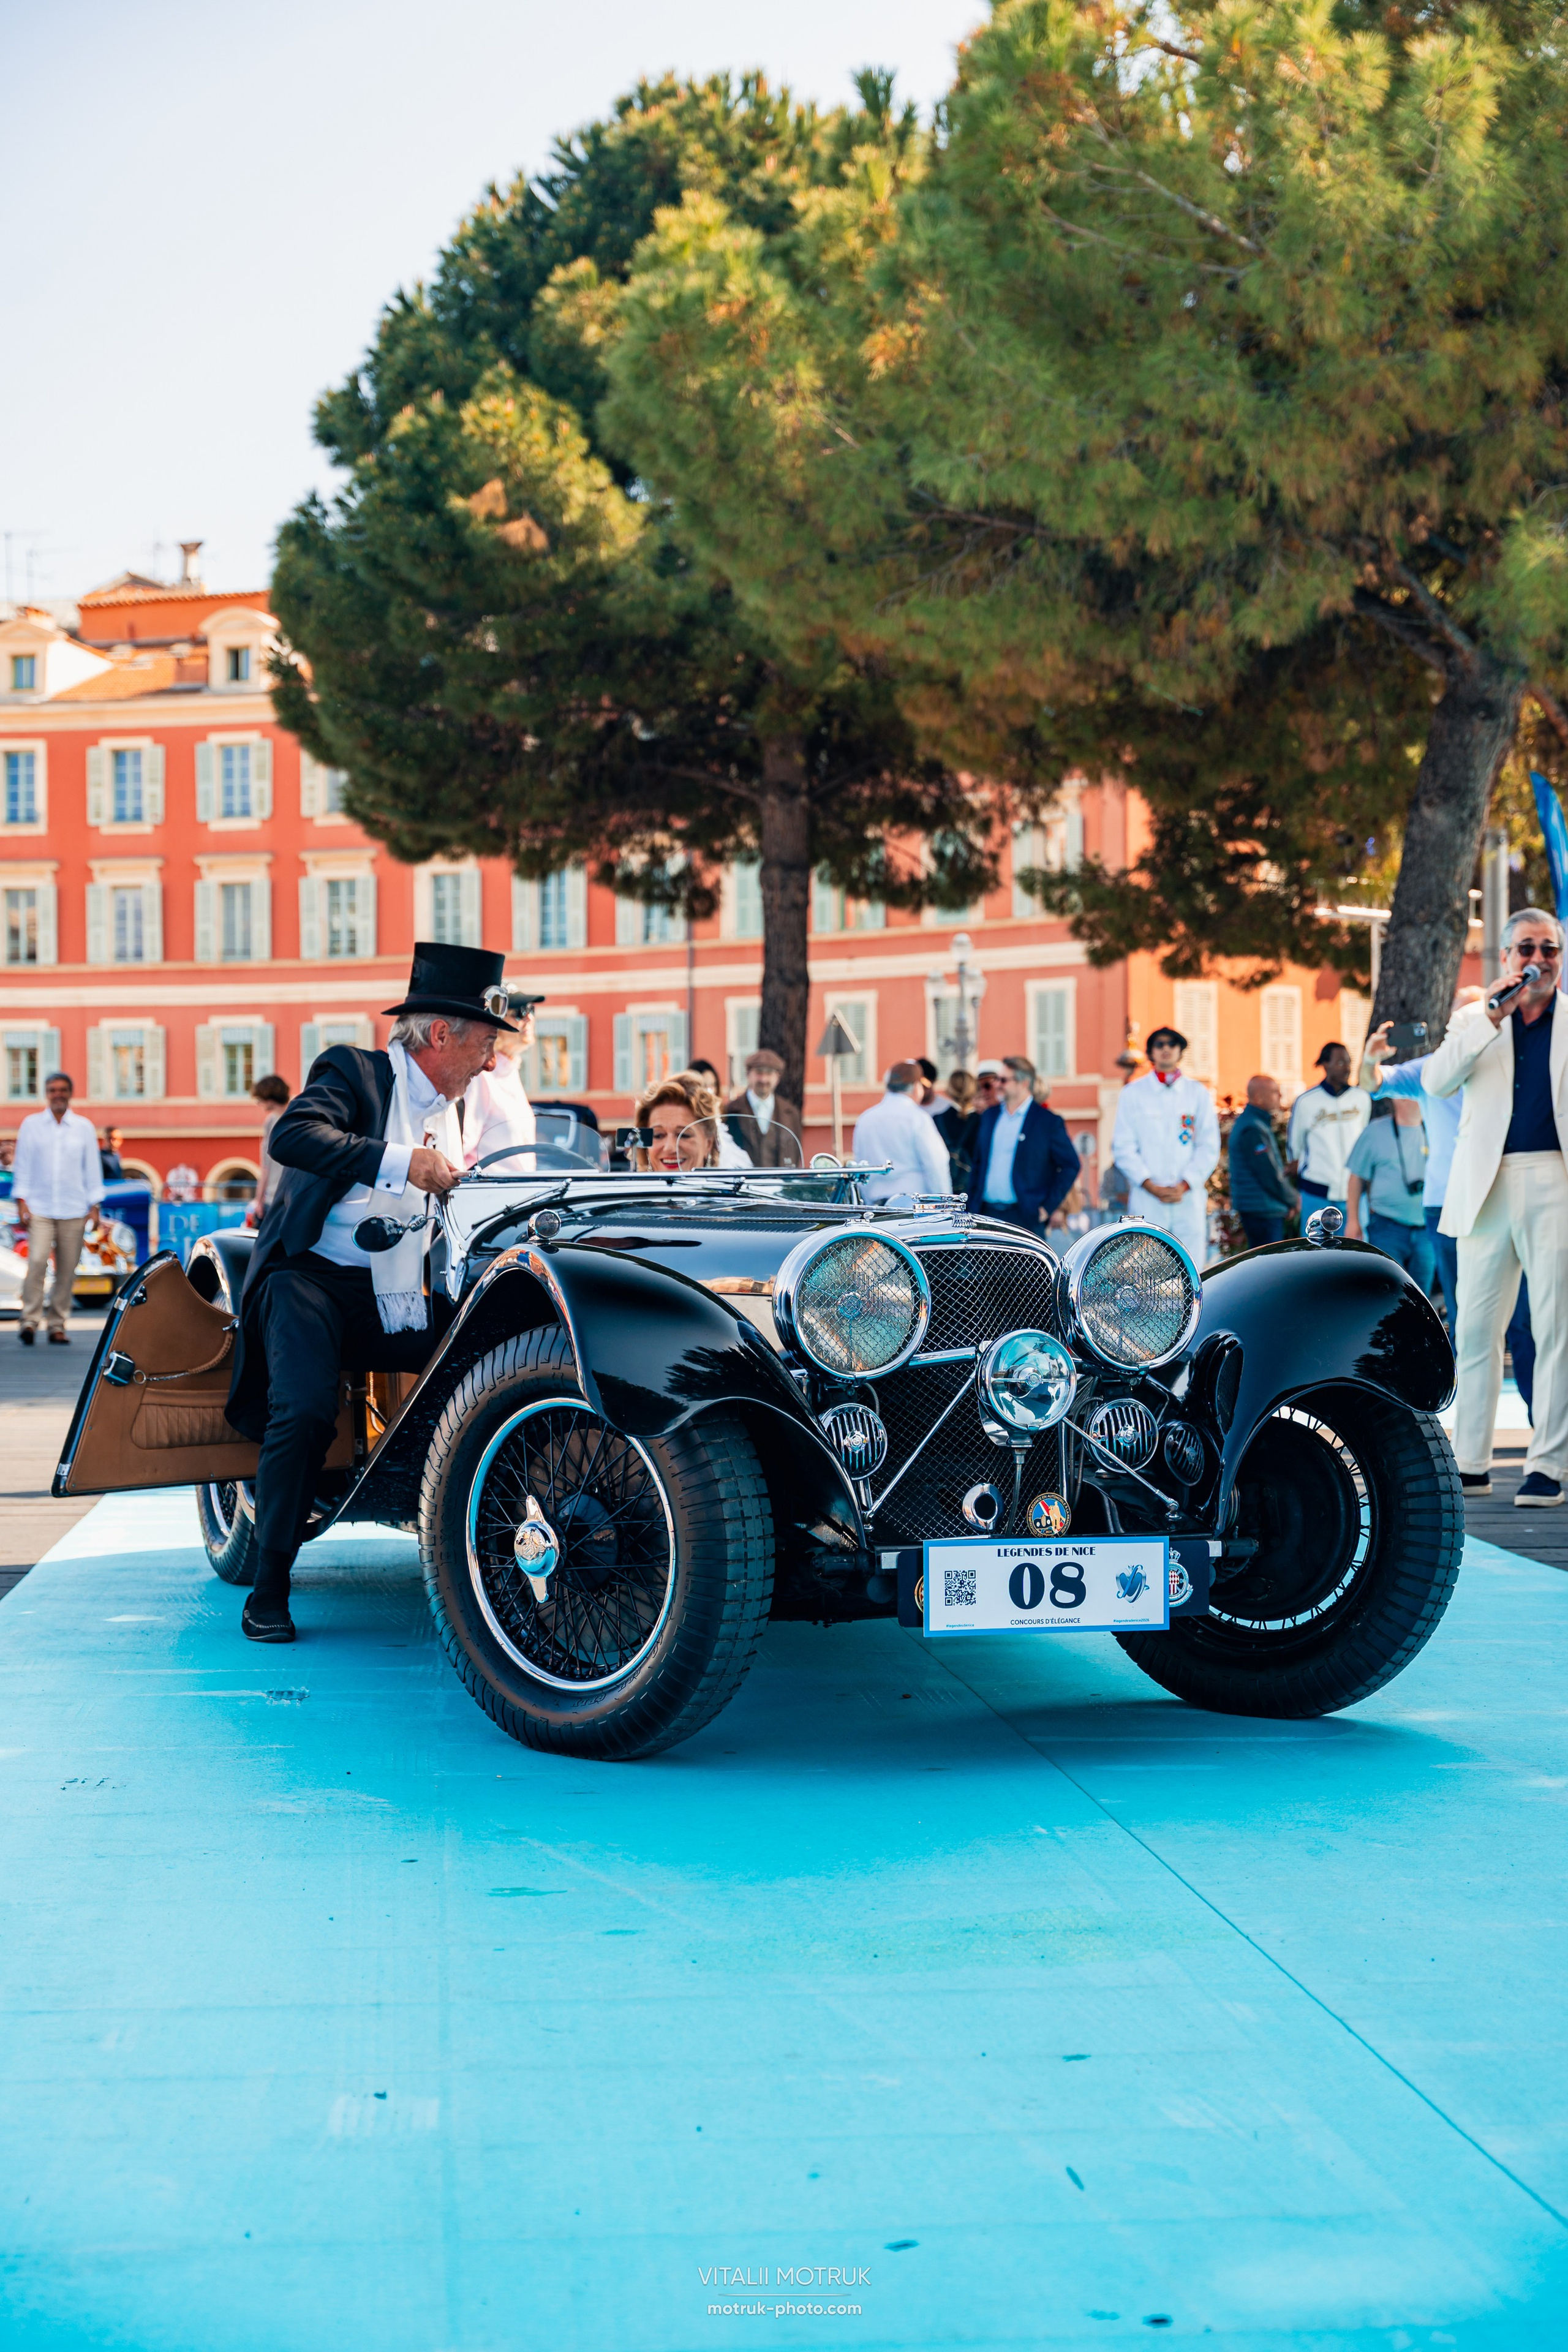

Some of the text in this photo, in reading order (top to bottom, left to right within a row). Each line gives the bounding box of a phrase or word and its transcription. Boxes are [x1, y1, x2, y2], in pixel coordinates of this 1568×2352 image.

[1047, 1494, 1066, 1506] AUTOMOBILE
[997, 1547, 1096, 1557] LEGENDES DE NICE
[1009, 1562, 1087, 1610] 08
